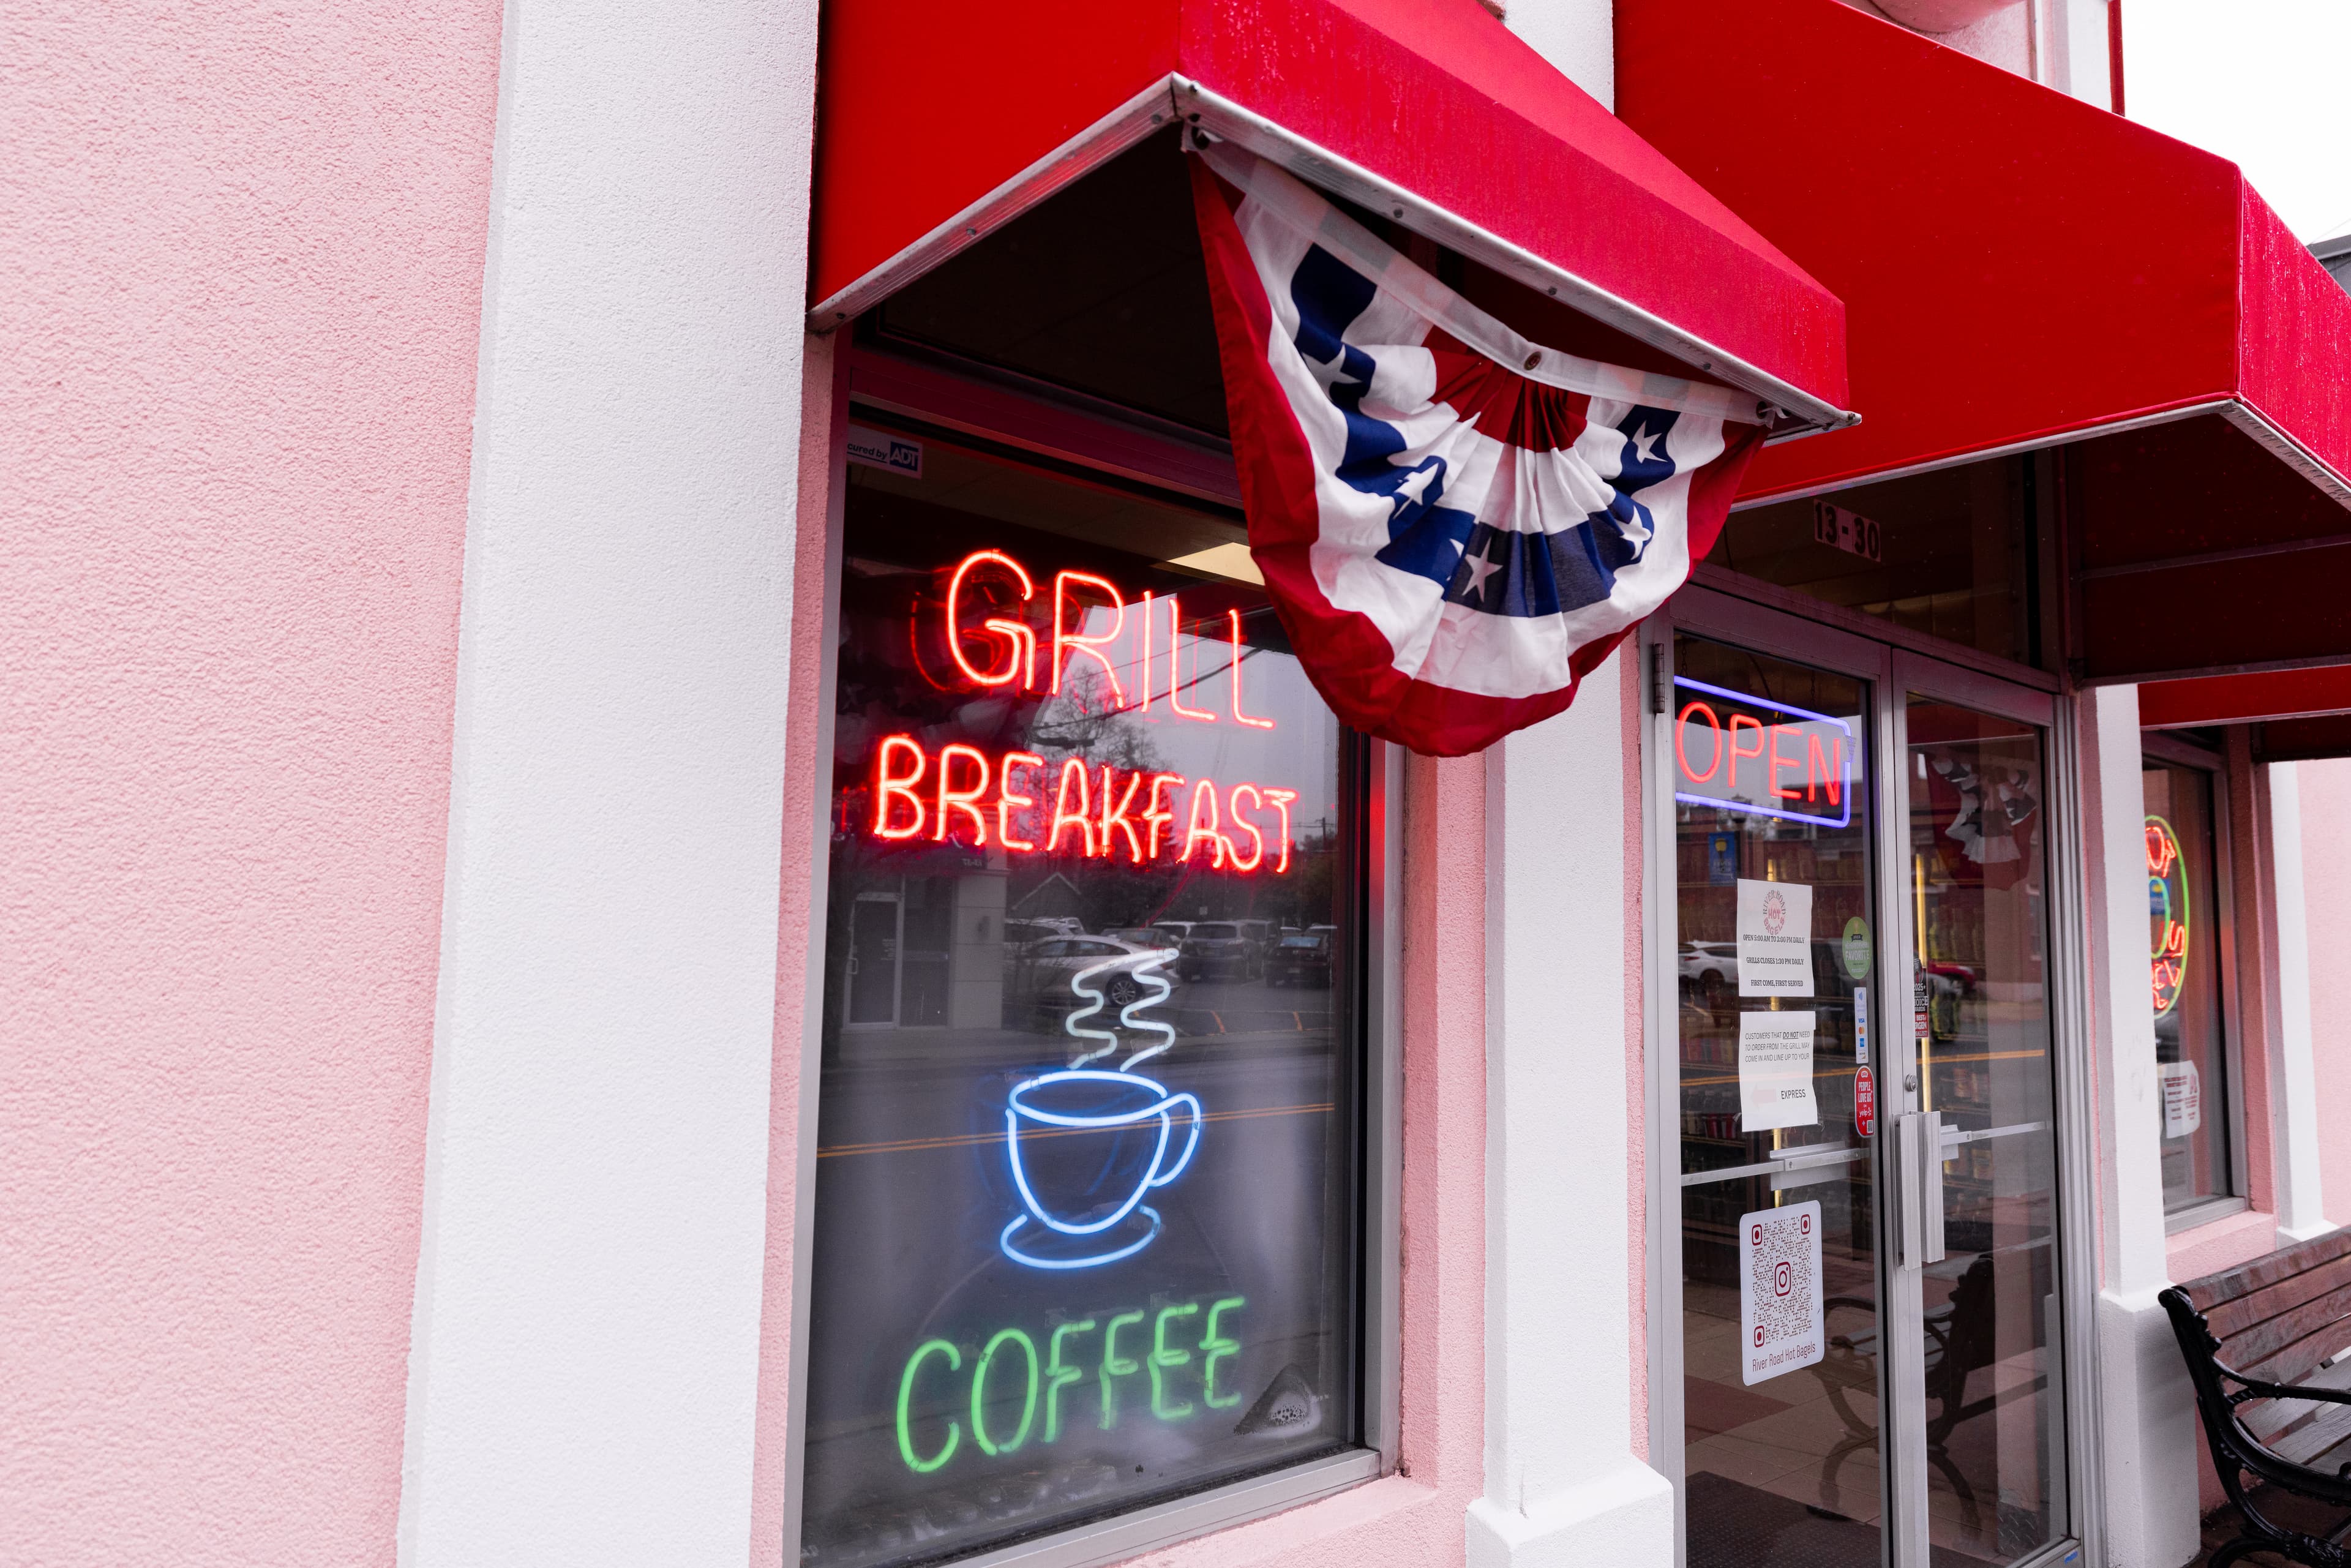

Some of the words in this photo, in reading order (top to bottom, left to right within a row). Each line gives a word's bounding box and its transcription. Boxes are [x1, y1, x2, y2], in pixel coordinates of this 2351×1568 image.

[848, 444, 877, 456] cured
[876, 449, 888, 461] by
[891, 447, 918, 469] ADT
[1815, 501, 1880, 560] 13-30
[946, 549, 1276, 729] GRILL
[1675, 701, 1840, 806] OPEN
[872, 734, 1297, 873] BREAKFAST
[2145, 826, 2177, 879] OT
[1763, 890, 1774, 914] RIVER
[1775, 890, 1786, 915] ROAD
[1768, 908, 1781, 920] HOT
[1763, 917, 1785, 936] BAGELS
[1845, 950, 1870, 961] FAVORITE
[1914, 983, 1924, 991] 025
[1780, 1089, 1806, 1100] EXPRESS
[1858, 1081, 1871, 1091] PEOPLE
[1858, 1092, 1867, 1103] LOVE
[1867, 1092, 1872, 1103] US
[1859, 1109, 1868, 1117] yelp
[1752, 1358, 1768, 1371] River
[1769, 1349, 1783, 1367] Road
[1785, 1348, 1796, 1361] Hot
[1797, 1341, 1815, 1359] Bagels
[896, 1296, 1245, 1473] COFFEE
